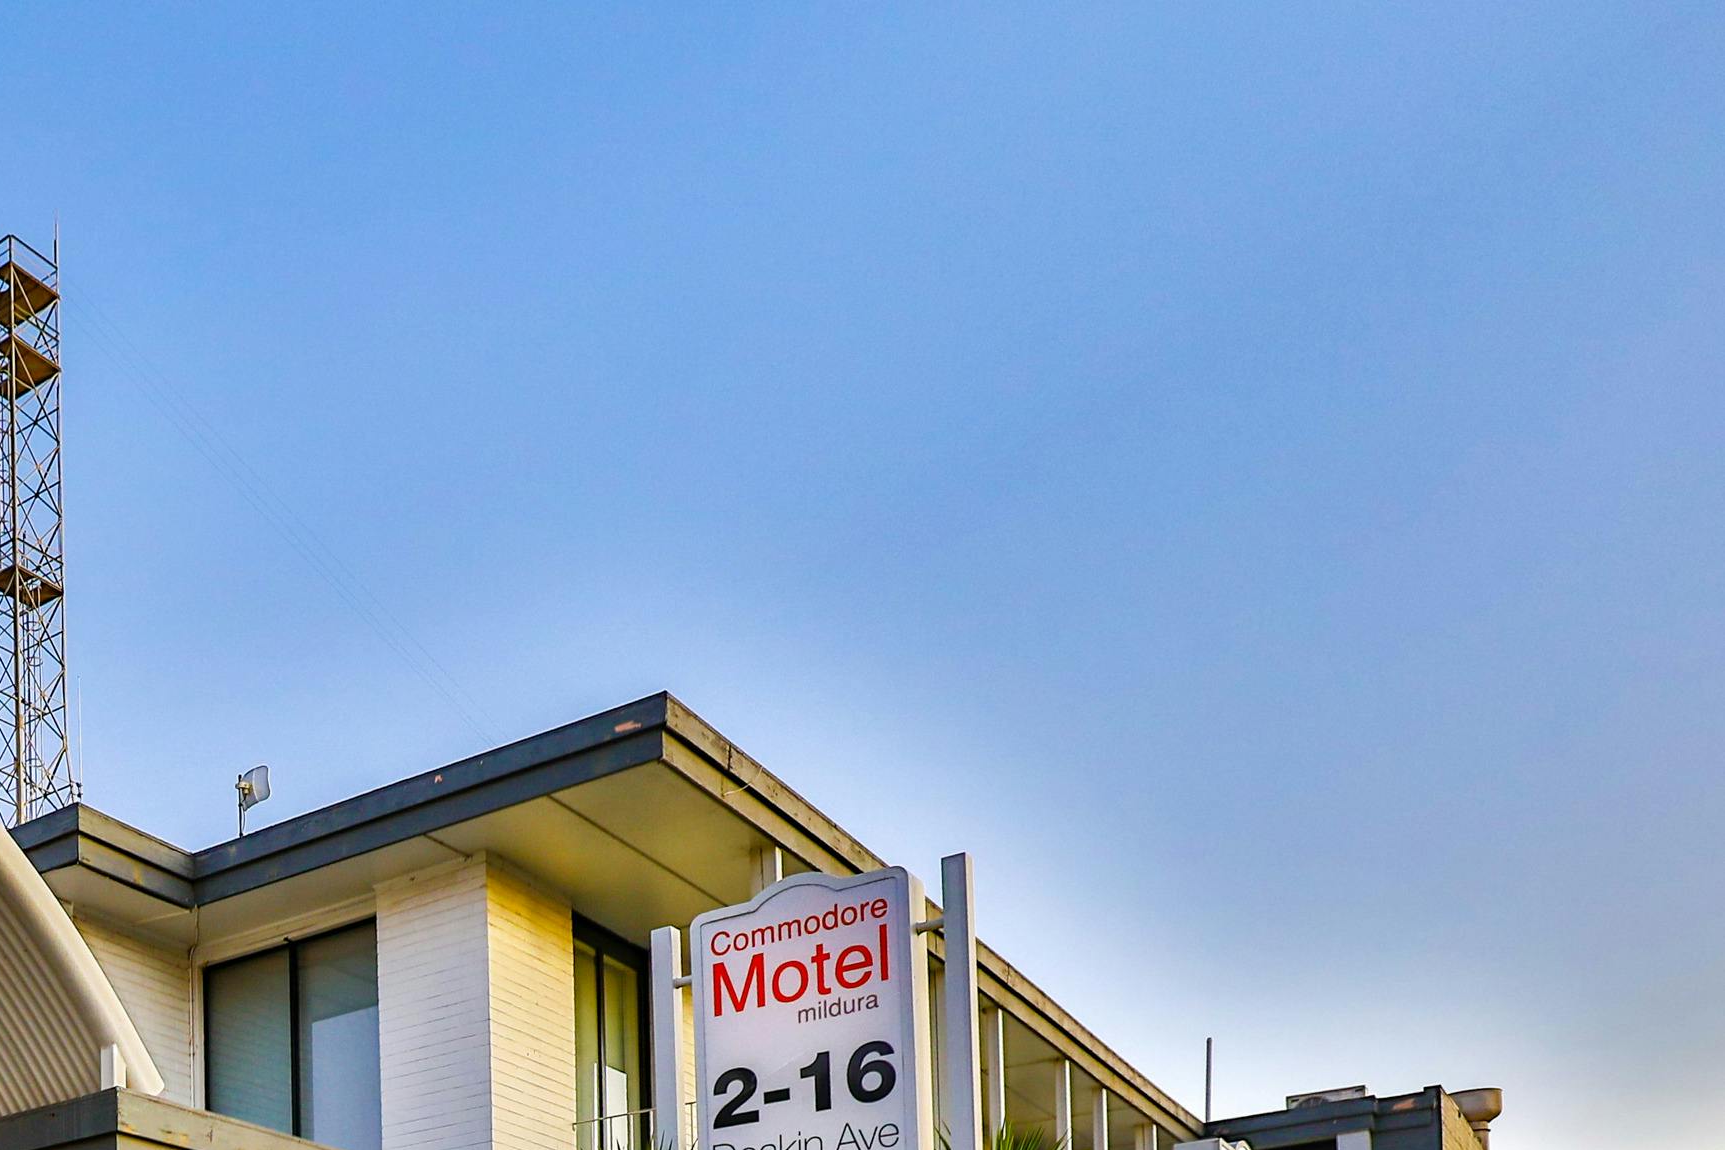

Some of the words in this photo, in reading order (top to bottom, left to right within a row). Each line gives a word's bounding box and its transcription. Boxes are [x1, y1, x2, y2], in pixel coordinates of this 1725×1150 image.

[710, 898, 888, 956] Commodore
[712, 923, 889, 1017] Motel
[797, 994, 880, 1024] mildura
[713, 1040, 897, 1130] 2-16
